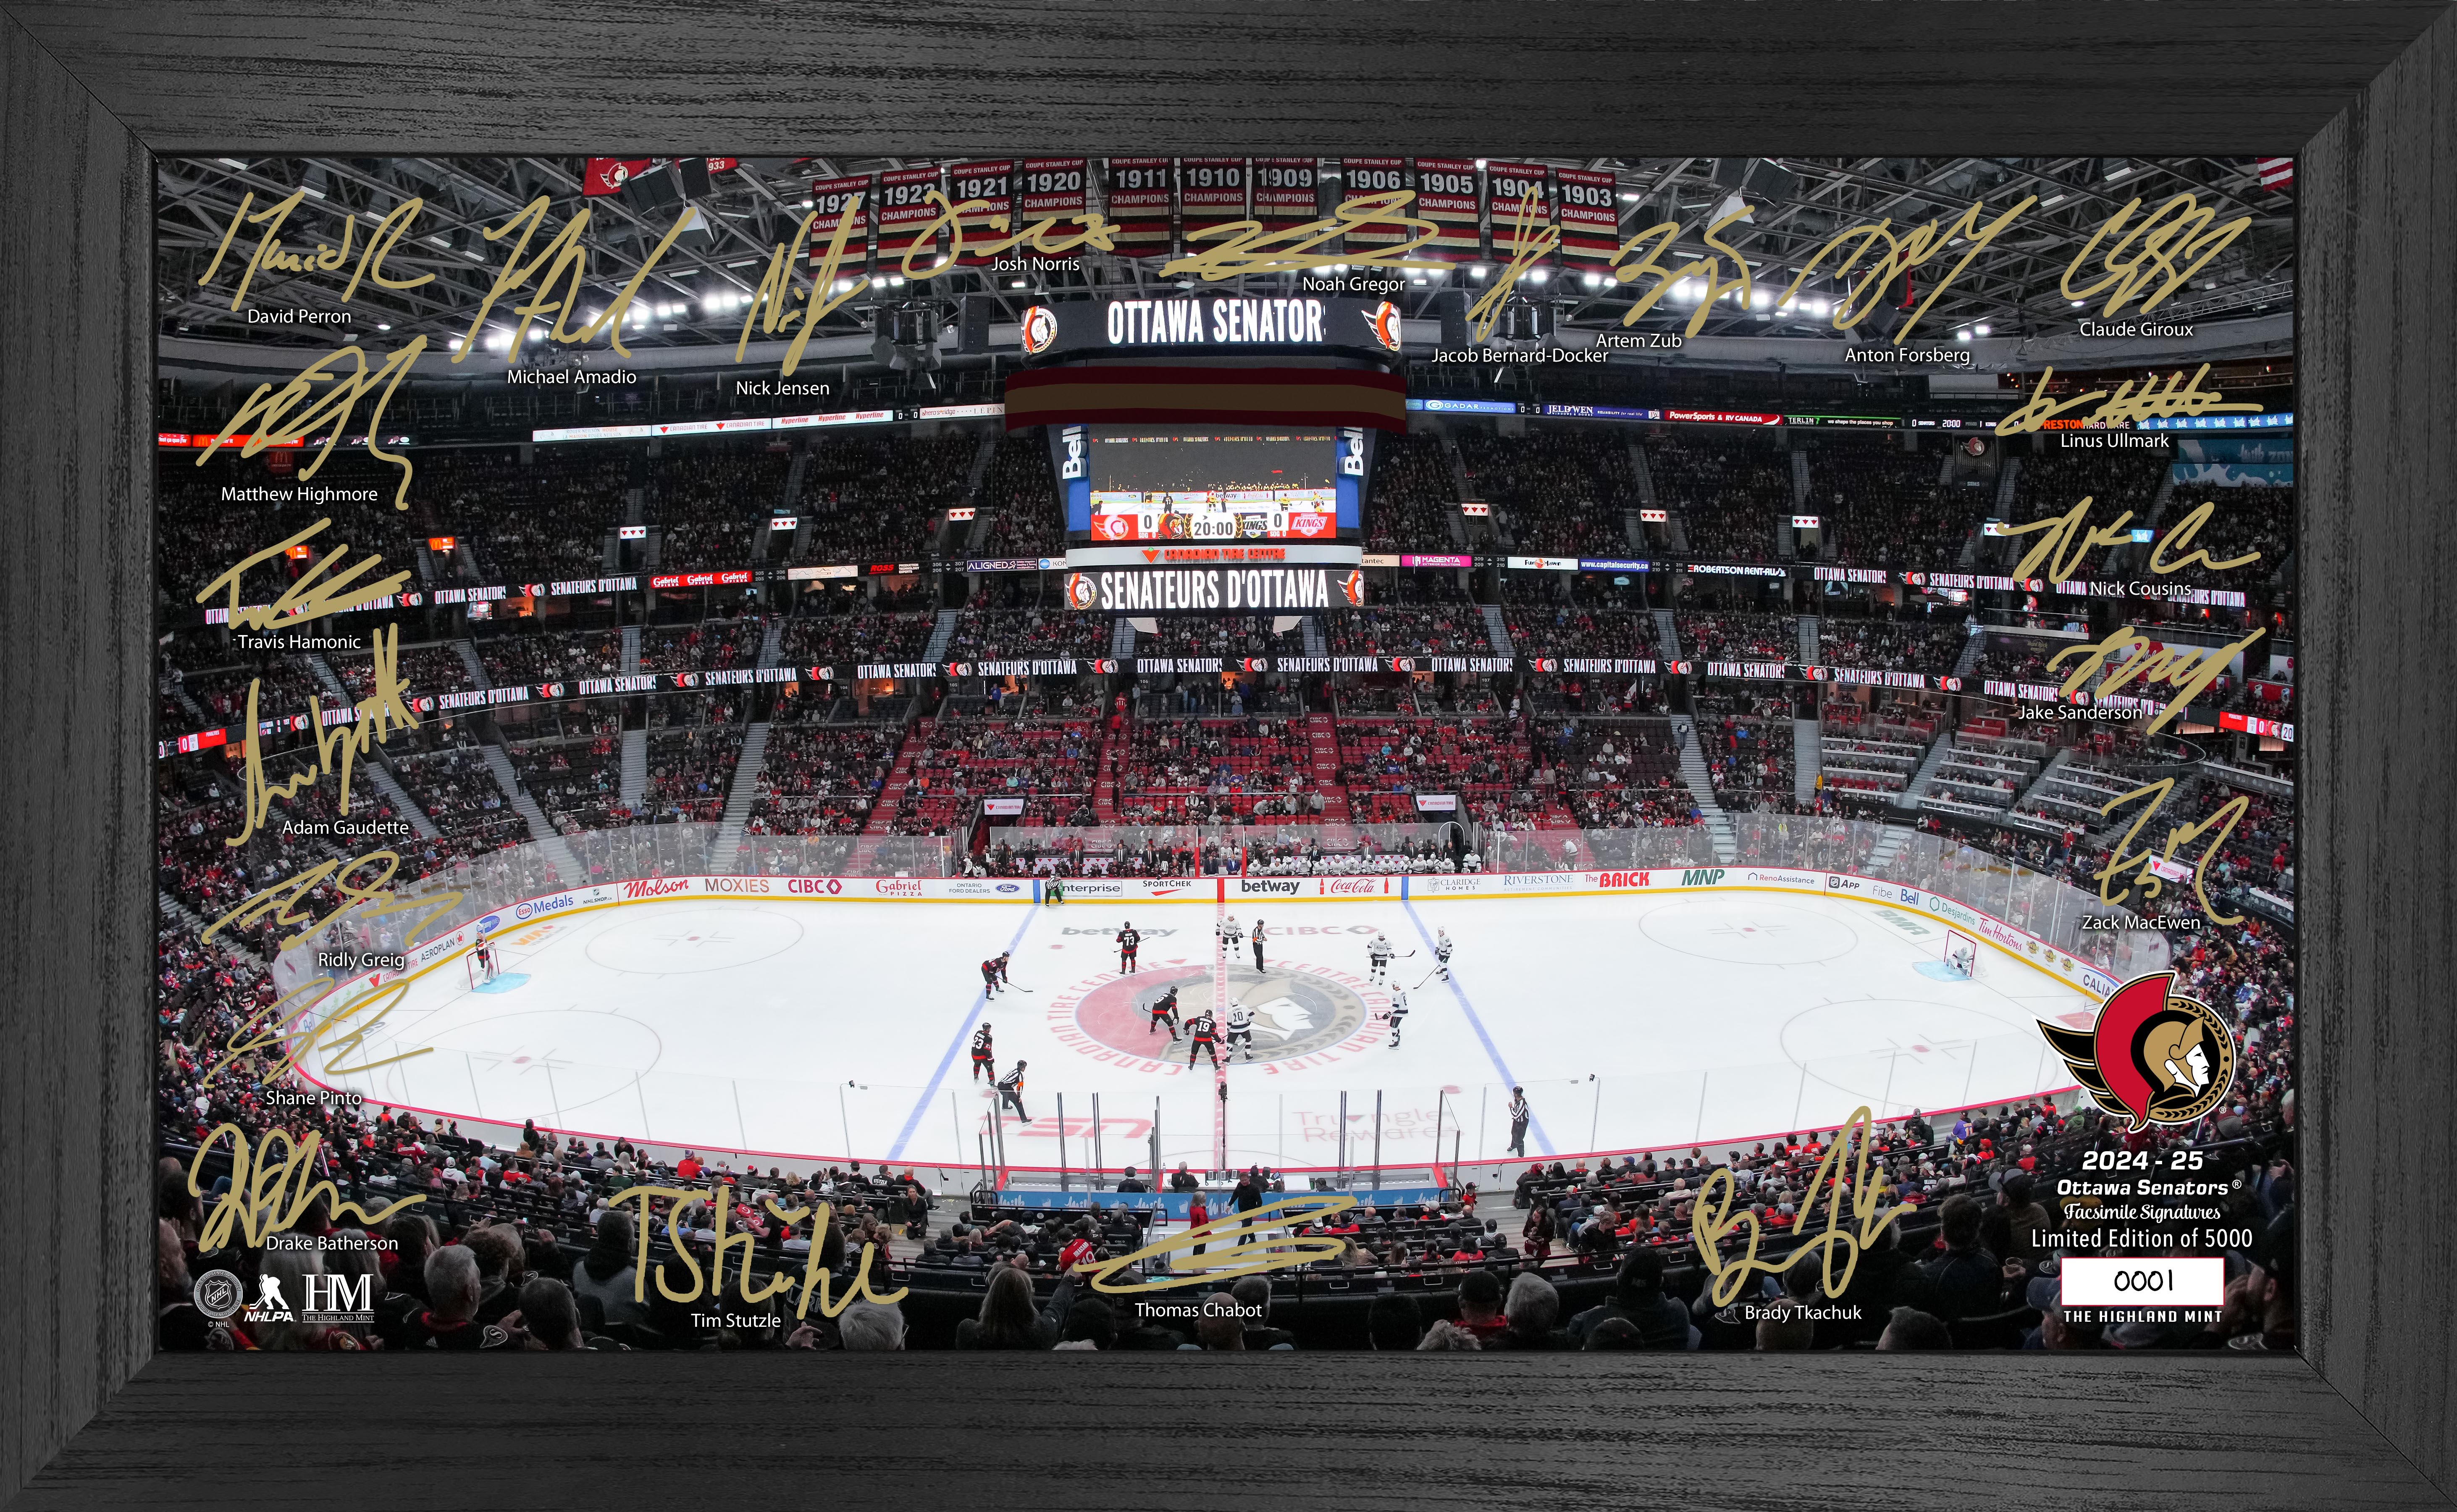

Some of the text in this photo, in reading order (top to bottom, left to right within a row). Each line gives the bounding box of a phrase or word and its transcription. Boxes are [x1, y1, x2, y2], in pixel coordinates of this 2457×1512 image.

[1028, 172, 1081, 192] 1920
[1116, 169, 1166, 188] 1911
[1186, 168, 1239, 186] 1910
[1258, 169, 1312, 186] 1909
[1347, 170, 1400, 189] 1906
[1420, 173, 1473, 194] 1905
[957, 176, 1006, 198] 1921
[1024, 197, 1082, 207] CHAMPIONS
[1111, 194, 1169, 204] CHAMPIONS
[1184, 193, 1243, 202] CHAMPIONS
[1562, 184, 1612, 207] 1903
[1419, 198, 1475, 210] CHAMPIONS
[882, 207, 936, 221] CHAMPIONS
[1562, 208, 1615, 222] CHAMPIONS
[1107, 299, 1326, 345] OTTAWA SENATOR
[1670, 412, 1715, 421] PowerSports
[1194, 522, 1233, 536] 20:00
[1296, 519, 1326, 528] KINGS
[1164, 548, 1286, 560] CANADIAN TIRE CENTRE
[1581, 561, 1648, 571] www.capitalsecurity.ca
[1693, 565, 1743, 574] ROBERTSON
[1101, 569, 1329, 609] SENATEURS D'OTTAWA
[978, 660, 1077, 676] SENATEURS D'OTTAWA
[1137, 659, 1174, 673] OTTAWA
[1431, 659, 1466, 672] OTTAWA
[705, 667, 797, 685] SENATEURS D'OTTAWA
[439, 687, 529, 709] SENATEURS D'OTTAWA
[1503, 874, 1573, 886] RIVERSTONE
[1585, 871, 1649, 887] The BRICK
[1681, 869, 1725, 886] MNP
[1759, 874, 1814, 885] RenoAssistance
[623, 879, 689, 898] Molson
[705, 878, 769, 892] MOXIES
[788, 879, 824, 894] CIBC
[876, 879, 922, 893] Gabriel
[1241, 879, 1300, 895] betway
[1331, 878, 1376, 894] Coca-Cola
[1872, 885, 1893, 899] Fibe
[583, 896, 612, 905] NHLSHOP.CA
[1900, 888, 1919, 906] Bell
[519, 907, 530, 915] Esso
[534, 895, 574, 914] Medals
[1942, 903, 1976, 926] Desjardins
[1264, 926, 1341, 935] CIBC
[1979, 917, 2023, 952] Tim Hortons
[1124, 937, 1135, 947] 73
[420, 938, 455, 962] AEROPLAN
[1233, 1012, 1243, 1022] 10
